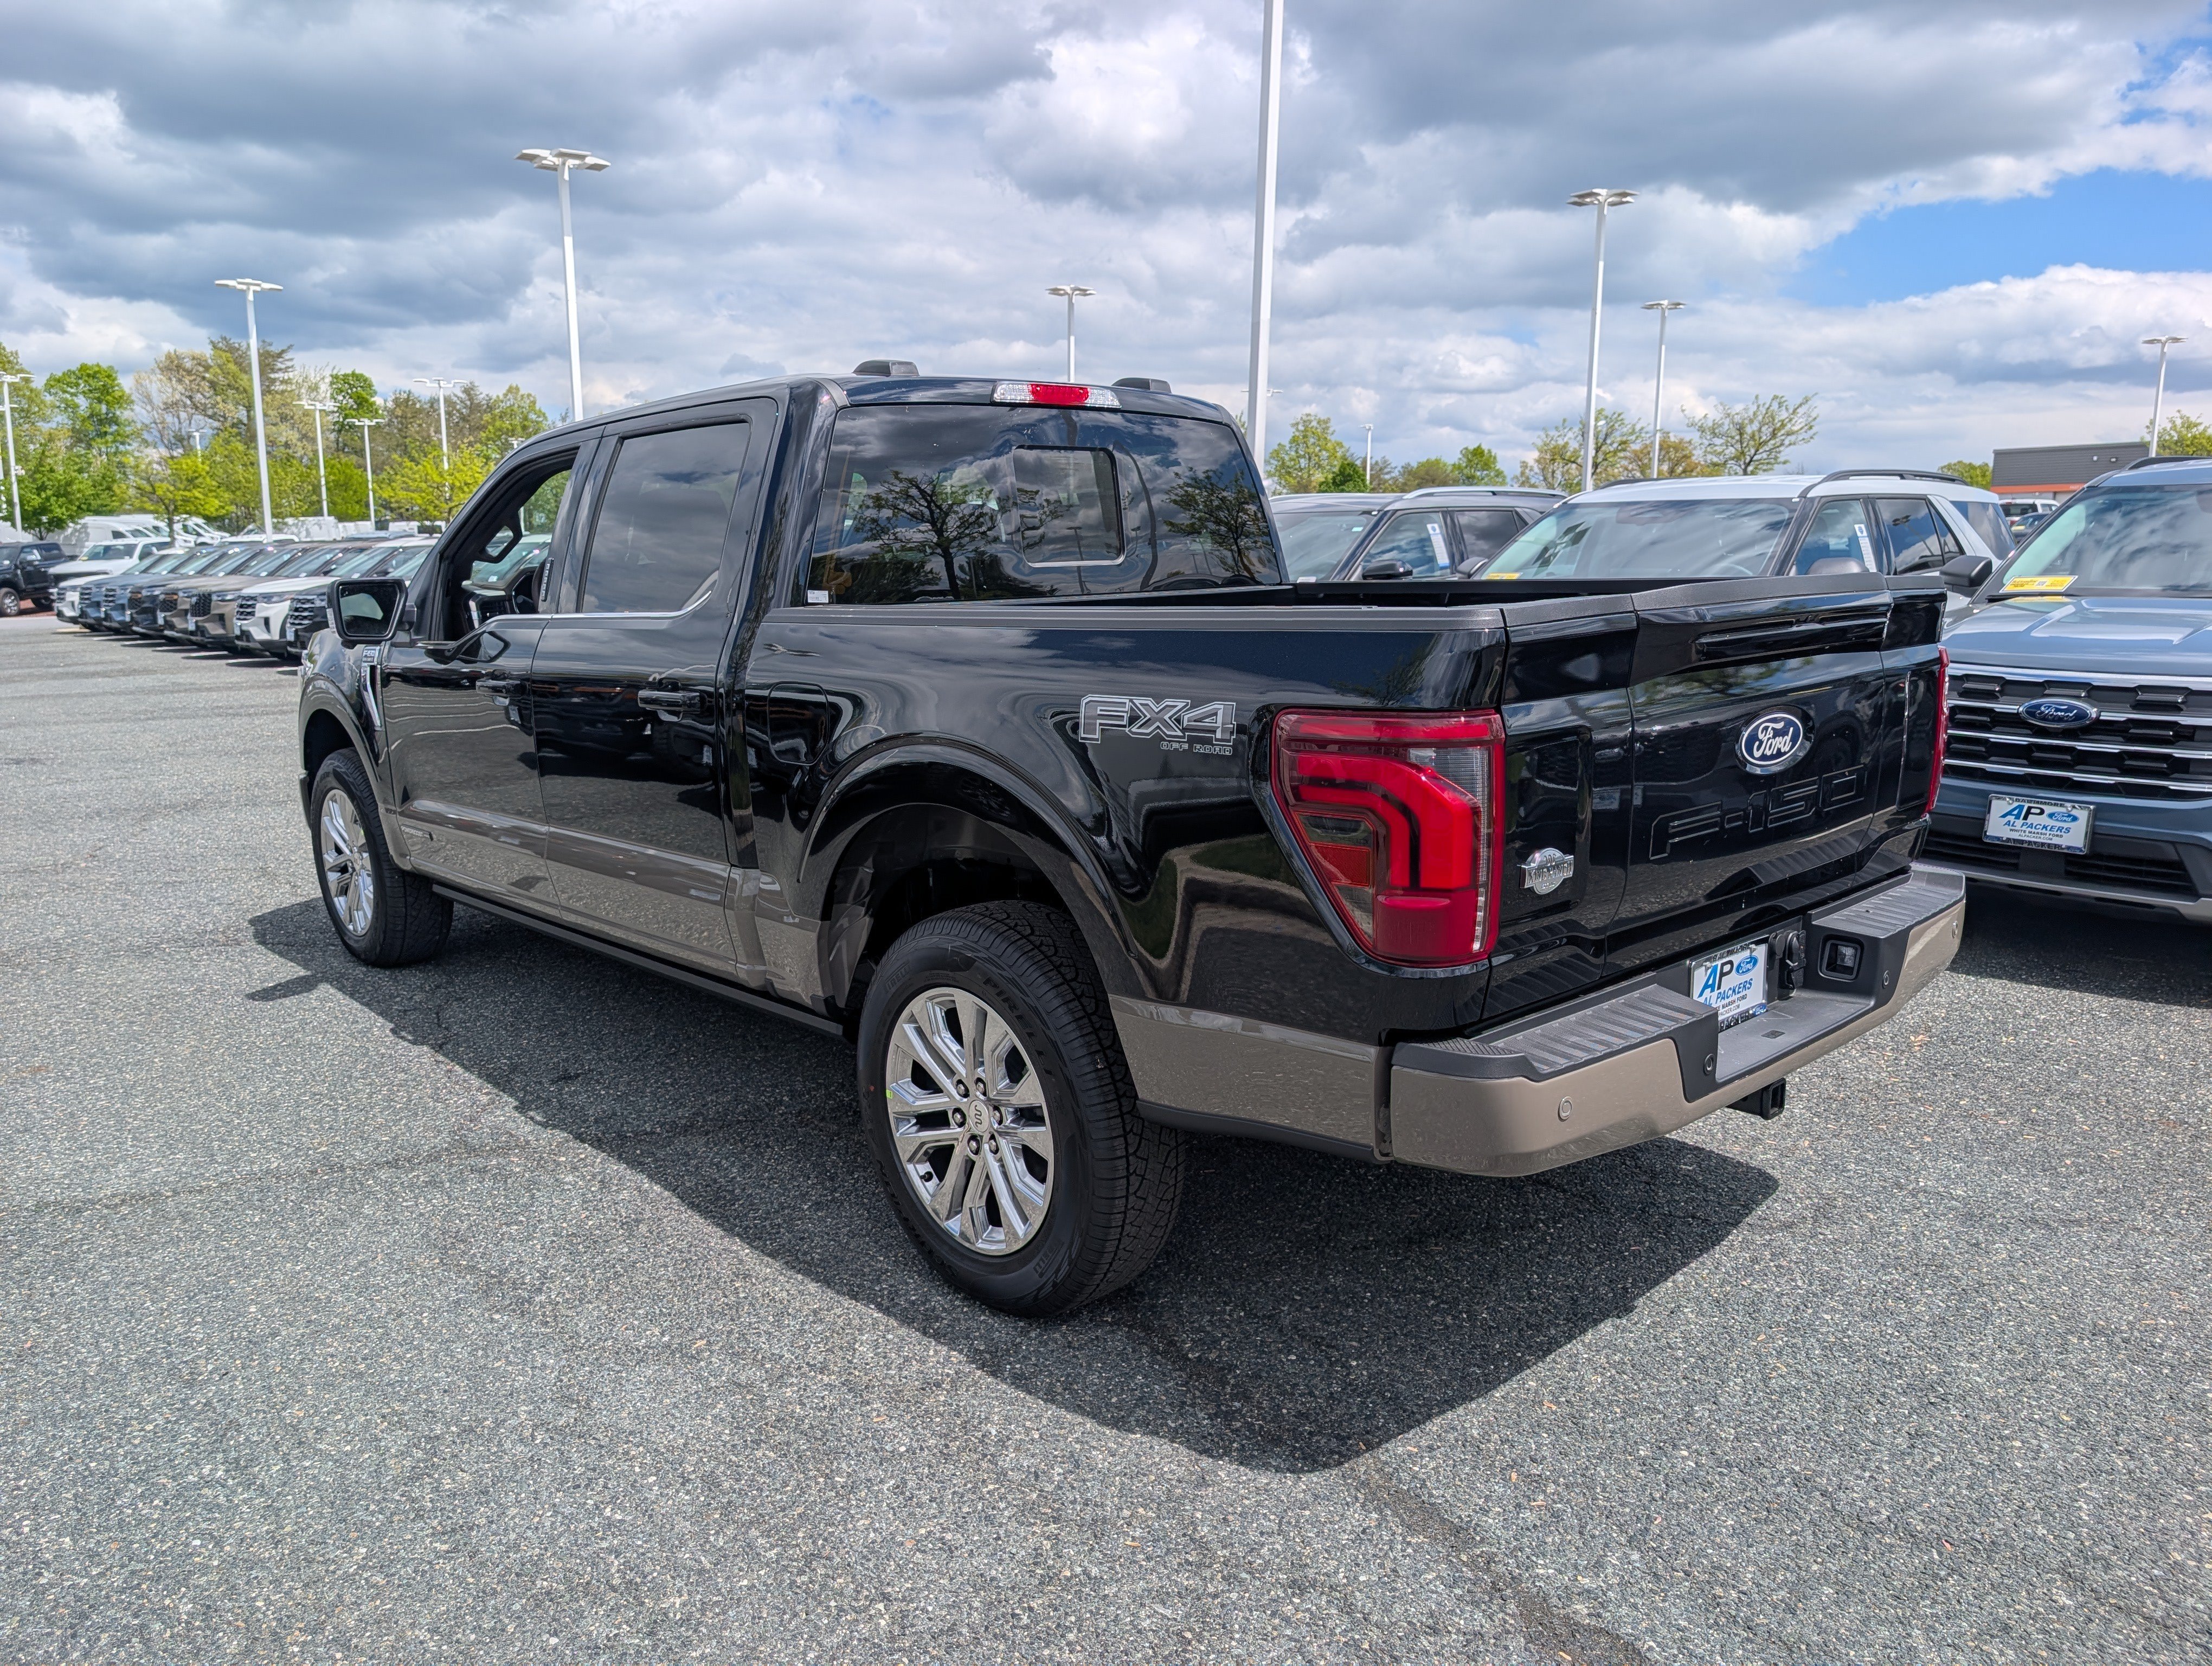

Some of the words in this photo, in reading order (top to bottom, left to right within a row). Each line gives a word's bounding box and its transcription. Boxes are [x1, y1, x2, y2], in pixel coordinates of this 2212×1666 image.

[1079, 694, 1237, 745] FX4
[2035, 703, 2078, 721] Ford
[1160, 741, 1188, 751] OFF
[1193, 744, 1233, 755] ROAD
[1753, 721, 1793, 758] Ford
[1649, 765, 1868, 860] F-150
[1998, 804, 2045, 821] AP
[2052, 811, 2073, 822] Ford
[2020, 821, 2072, 834] PACKERS
[1739, 959, 1754, 973] Ford
[1697, 959, 1734, 998] AP
[1715, 978, 1753, 1004] PACKERS
[1719, 1004, 1740, 1017] PACKER.COM
[1721, 999, 1736, 1010] MARSH
[1737, 994, 1747, 1003] FORD
[982, 976, 1054, 1077] PIRELLI
